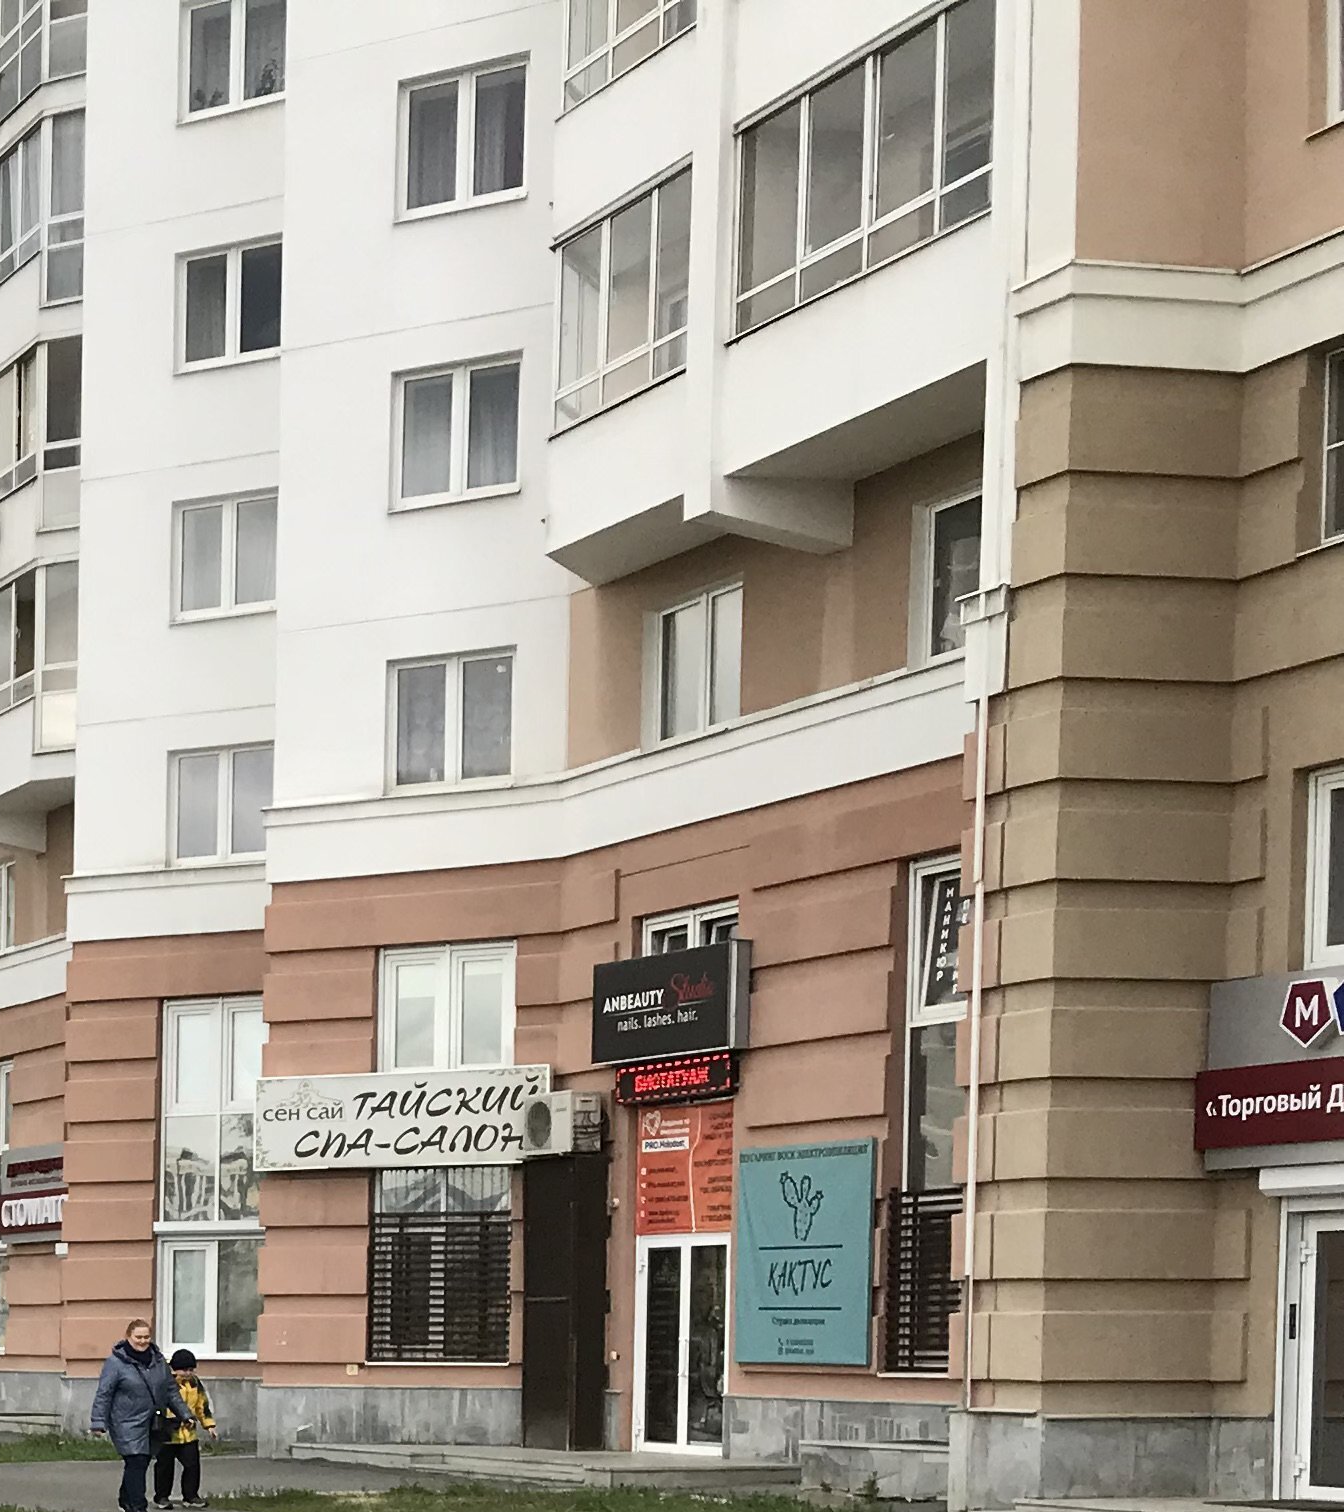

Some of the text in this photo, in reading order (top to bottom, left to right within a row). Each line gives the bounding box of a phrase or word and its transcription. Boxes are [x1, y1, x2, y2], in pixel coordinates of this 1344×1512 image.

[602, 988, 665, 1014] ANBEAUTY
[1294, 994, 1319, 1028] М
[617, 1008, 699, 1032] nails. lashes. hair.
[262, 1102, 343, 1122] сен сай
[1205, 1084, 1321, 1121] «Торговый
[768, 1258, 832, 1296] КАКТУС
